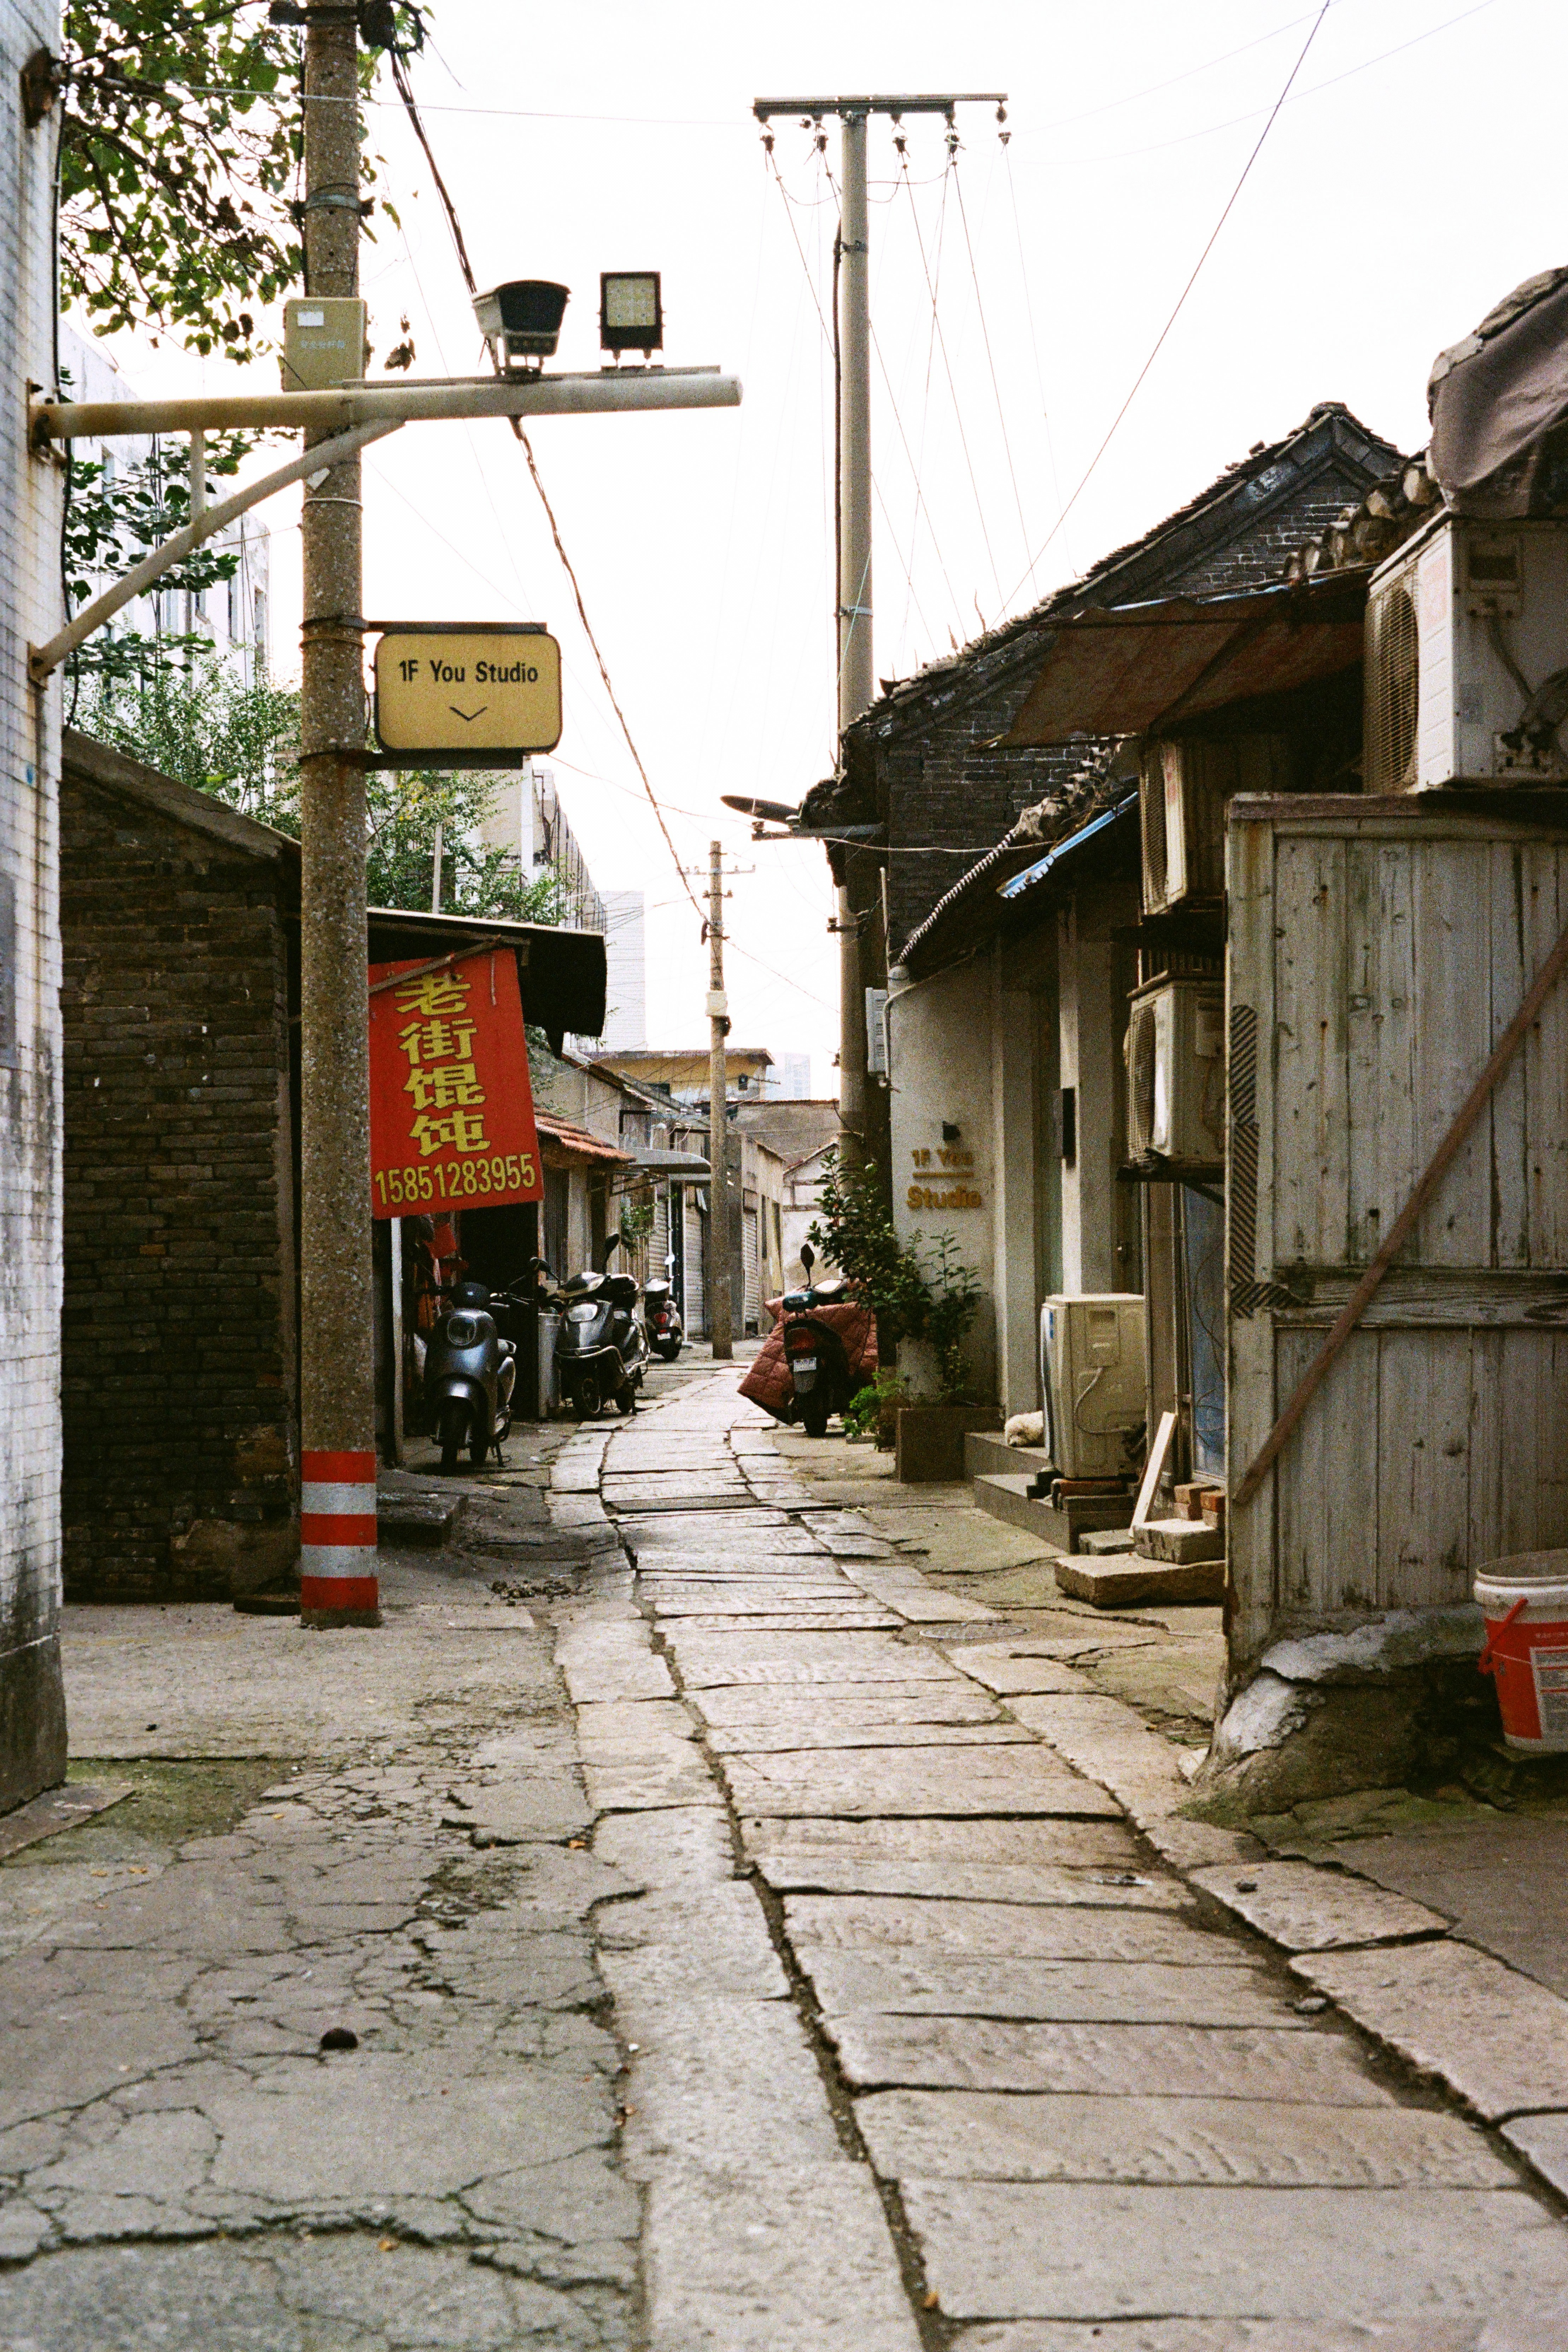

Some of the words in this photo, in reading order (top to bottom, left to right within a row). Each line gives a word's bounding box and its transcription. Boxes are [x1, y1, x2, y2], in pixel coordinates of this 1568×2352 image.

[399, 660, 418, 681] 1F
[430, 660, 465, 682] You
[475, 661, 539, 683] Studio
[394, 972, 491, 1157] 老街馄饨
[912, 1148, 931, 1167] 1F
[937, 1148, 974, 1166] You
[374, 1153, 536, 1205] 15851283955
[906, 1185, 982, 1209] Studio
